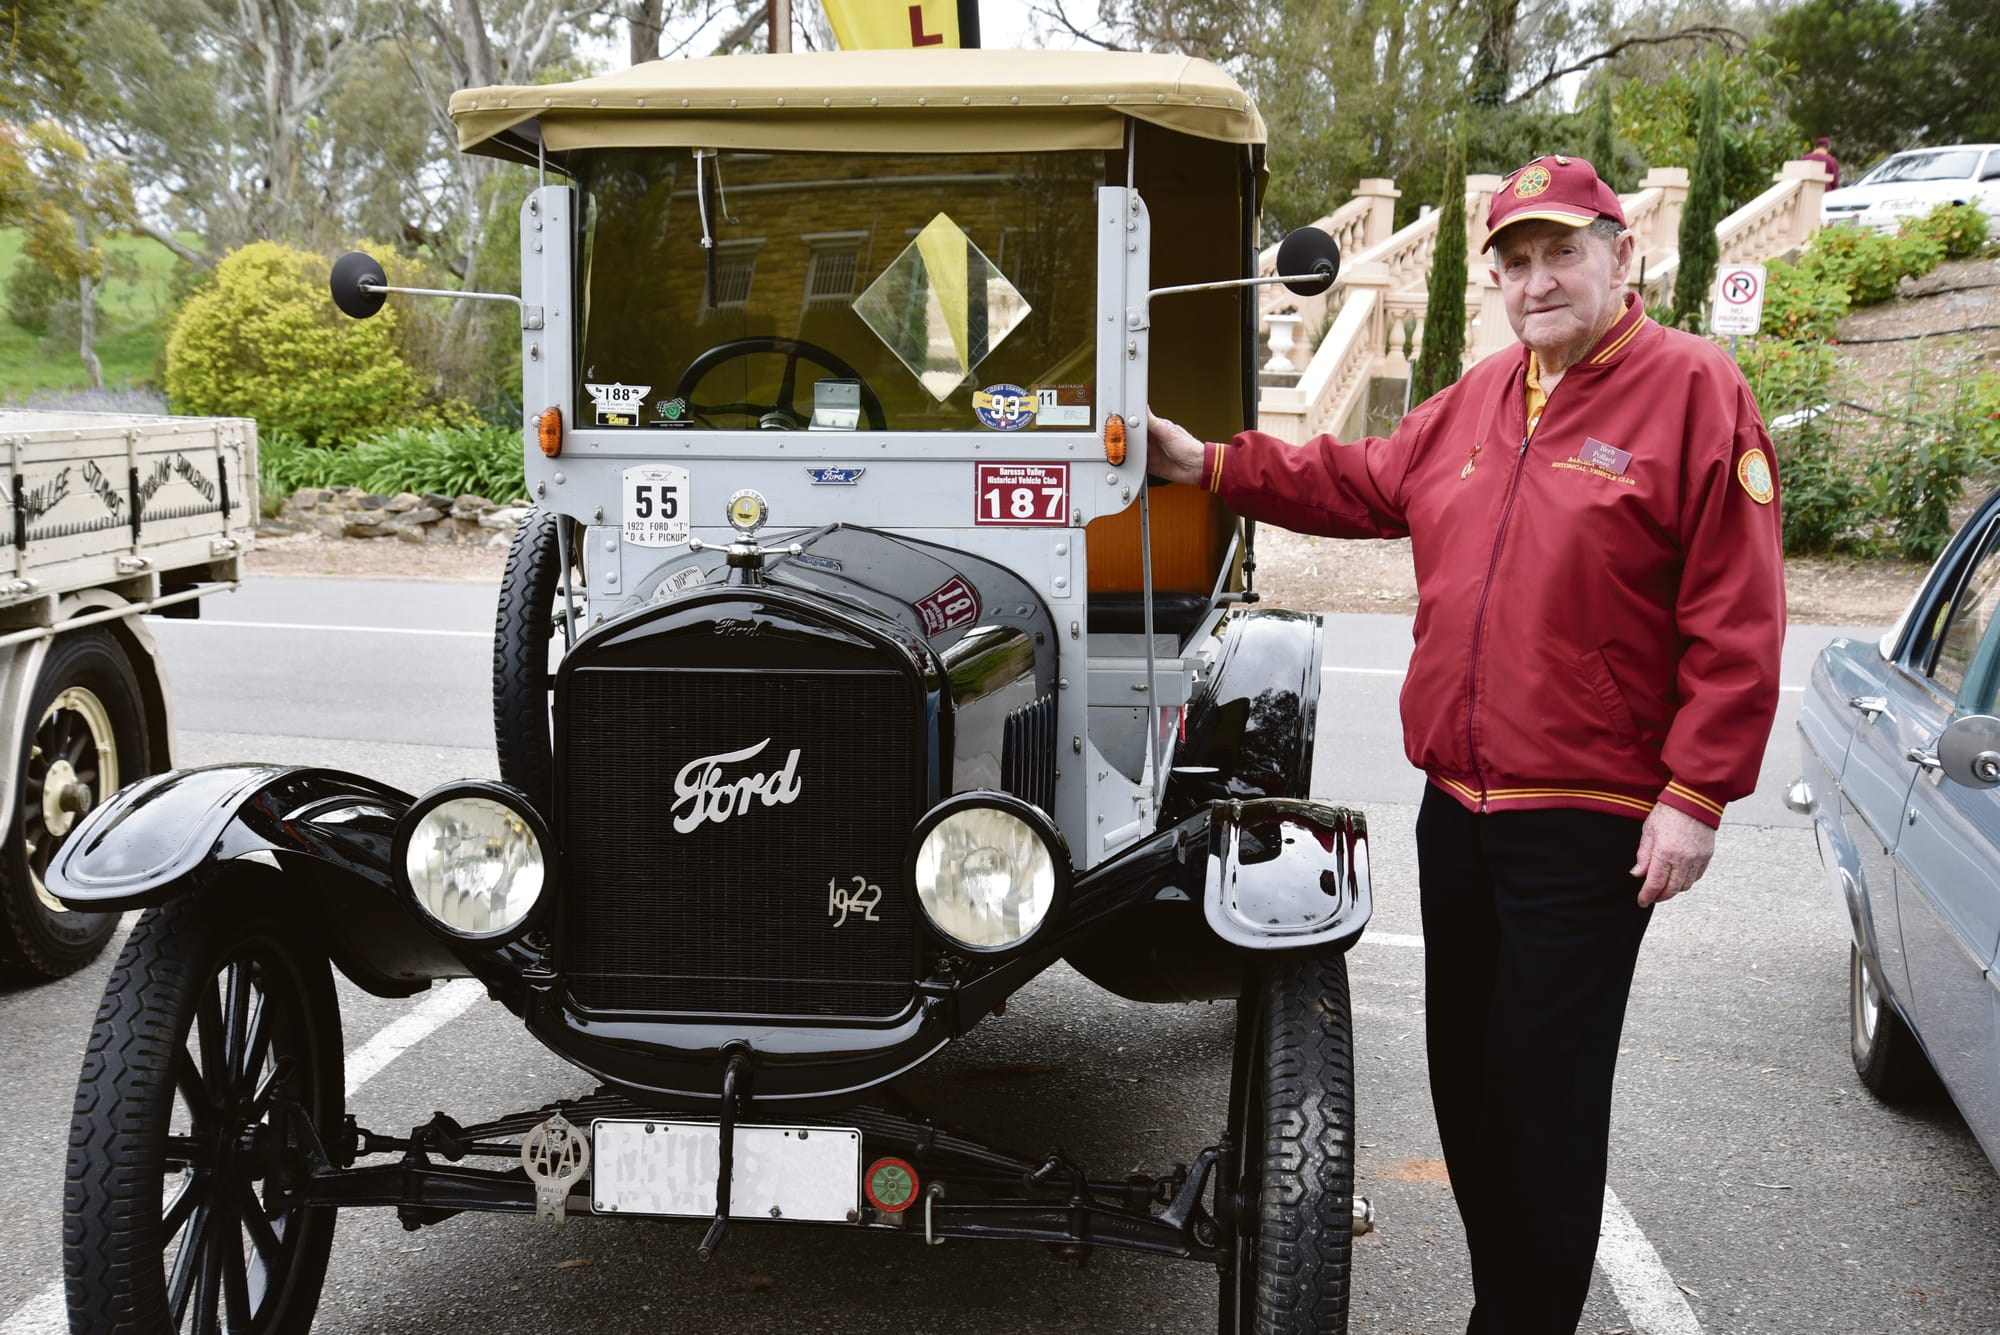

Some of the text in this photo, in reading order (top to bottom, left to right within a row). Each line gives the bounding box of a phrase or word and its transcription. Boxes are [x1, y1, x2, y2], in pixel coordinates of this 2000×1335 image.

[908, 5, 944, 48] L
[605, 387, 630, 401] 188
[1039, 391, 1053, 406] 11
[990, 394, 1020, 420] 93
[822, 470, 846, 480] Ford
[999, 467, 1046, 477] Barossa Valley
[987, 476, 1057, 485] Historical Vehicle Club
[984, 487, 1063, 519] 187
[627, 521, 645, 531] 1922
[650, 521, 669, 531] FORD
[630, 532, 685, 542] D & F PICKUP
[670, 737, 802, 834] Ford
[827, 875, 882, 928] 1922
